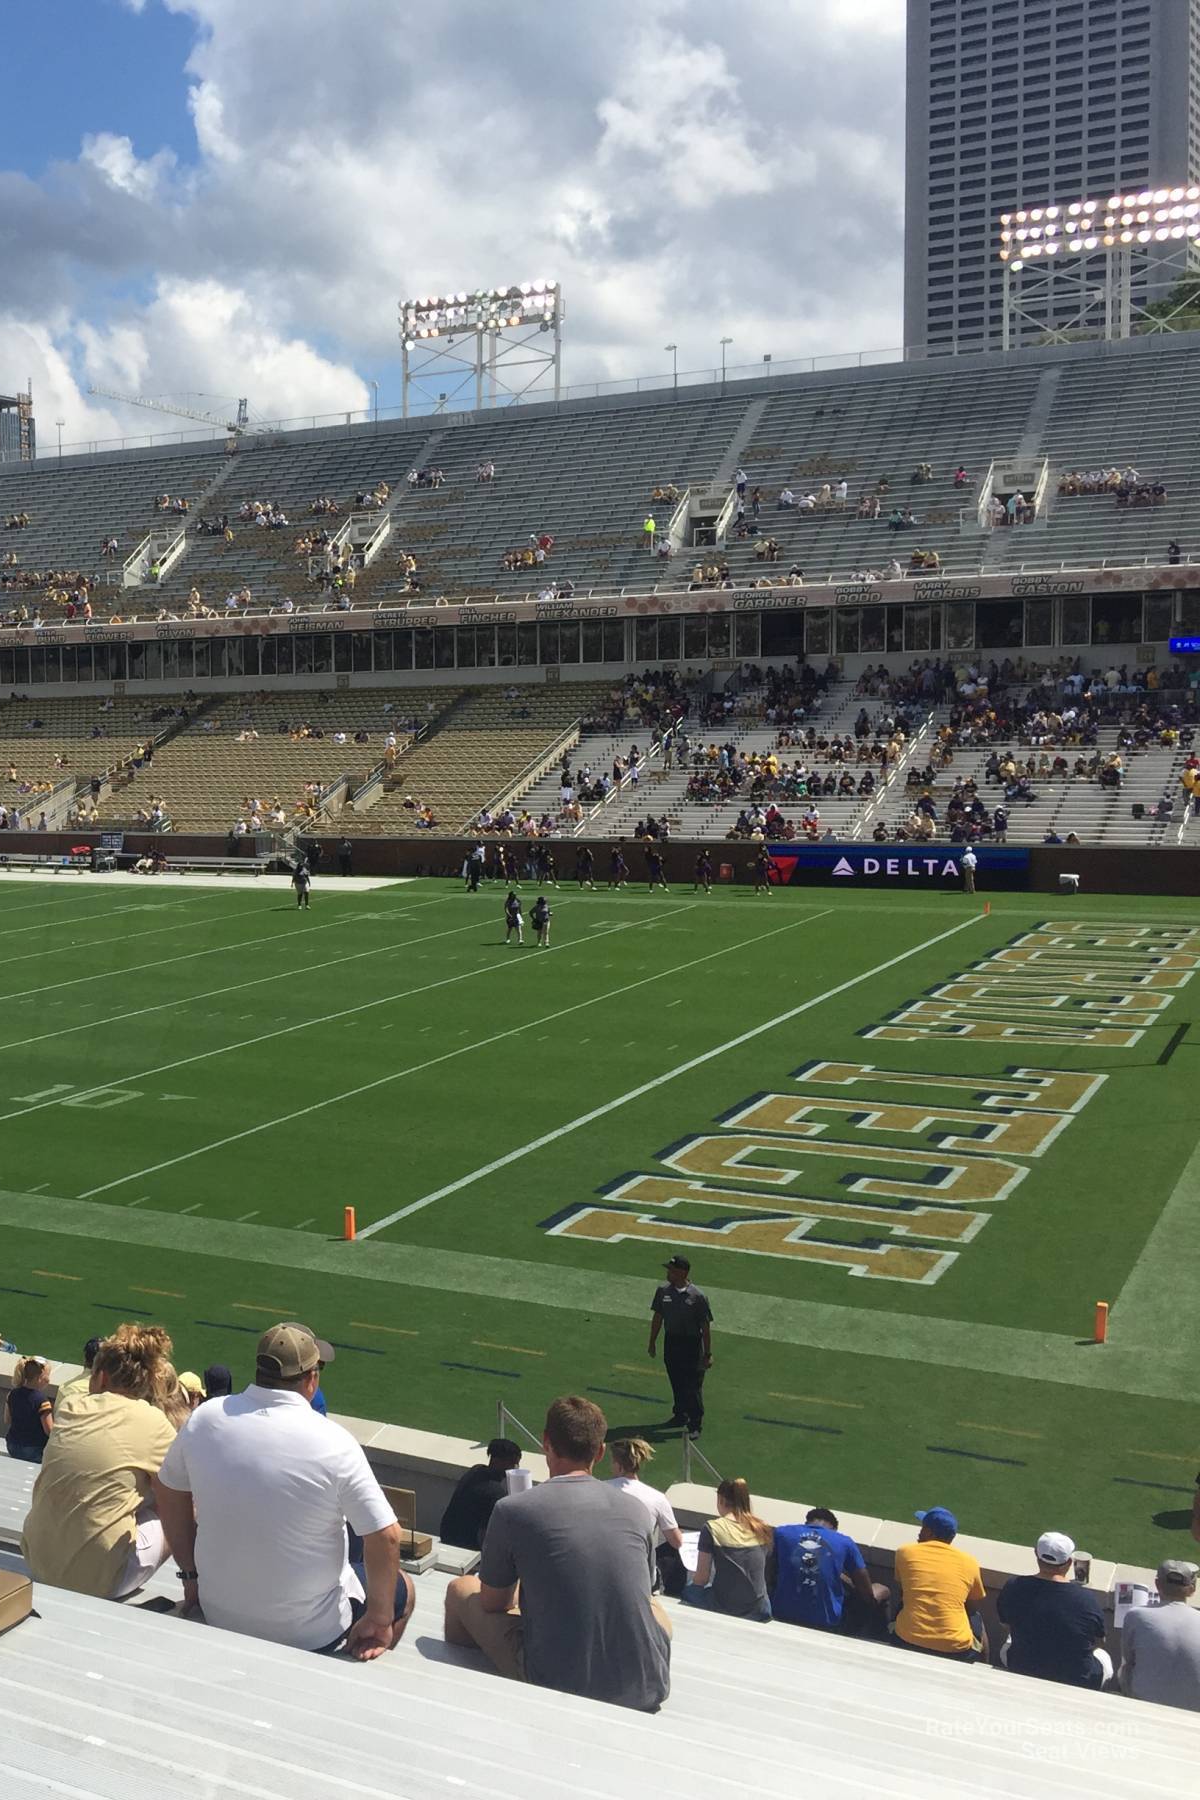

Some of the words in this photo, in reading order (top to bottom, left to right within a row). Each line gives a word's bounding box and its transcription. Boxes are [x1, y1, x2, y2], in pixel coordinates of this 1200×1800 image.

[916, 588, 981, 599] MORRIS
[1014, 583, 1083, 594] GASTON
[734, 597, 806, 608] GARDNER
[837, 593, 881, 604] DODD
[461, 613, 516, 623] FINCHER
[537, 607, 617, 618] ALEXANDER
[374, 616, 437, 626] STRUPPER
[290, 622, 344, 632] HEISMAN
[86, 632, 134, 641] FLOWERS
[158, 629, 195, 638] GUYON
[864, 858, 959, 876] DELTA
[855, 921, 1200, 1047] GEORGIA
[9, 1084, 146, 1109] 10
[544, 1061, 1109, 1285] TECH
